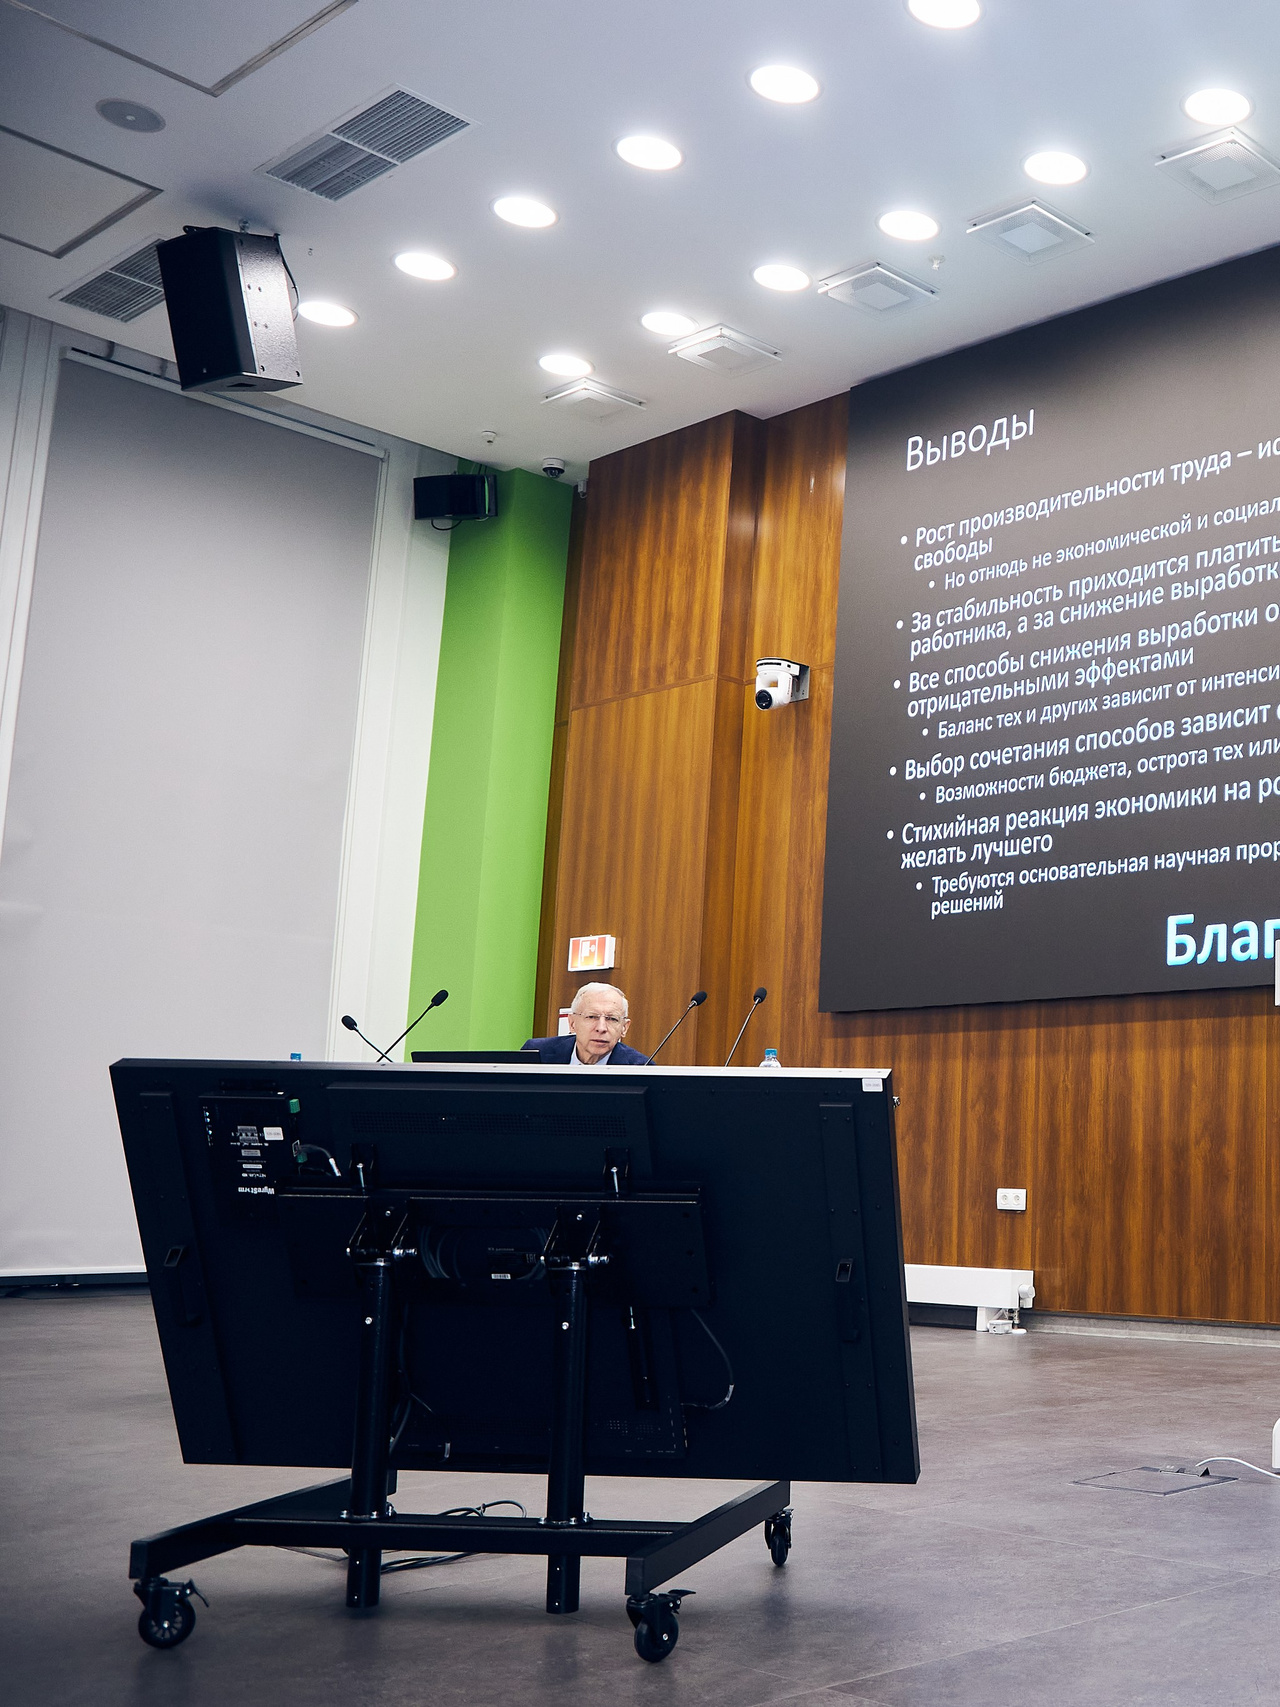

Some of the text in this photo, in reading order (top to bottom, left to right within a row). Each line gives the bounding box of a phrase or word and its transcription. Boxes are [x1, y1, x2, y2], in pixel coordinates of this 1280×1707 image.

[906, 408, 1035, 472] Выводы
[916, 522, 956, 548] Рост
[959, 467, 1165, 539] производительности
[1170, 450, 1231, 485] труда
[914, 537, 993, 571] свободы
[944, 571, 966, 590] Но
[969, 558, 1028, 584] отнюдь
[1032, 552, 1052, 569] не
[1056, 512, 1192, 563] экономической
[1197, 514, 1208, 530] и
[910, 611, 931, 633] За
[936, 584, 1063, 627] стабильность
[1068, 555, 1189, 601] приходится
[910, 620, 1012, 662] работника,
[1017, 615, 1028, 634] а
[1033, 610, 1054, 630] за
[1060, 586, 1164, 624] снижение
[909, 671, 940, 693] Все
[944, 650, 1024, 686] способы
[1029, 632, 1131, 669] снижения
[1138, 607, 1258, 648] выработки
[907, 646, 1194, 720] отрицательными эффектами
[938, 716, 993, 739] Баланс
[996, 710, 1022, 729] тех
[1026, 707, 1037, 724] и
[1039, 696, 1098, 725] других
[1101, 683, 1173, 710] зависит
[1176, 679, 1198, 697] от
[905, 752, 965, 781] Выбор
[969, 737, 1070, 770] сочетания
[1075, 717, 1175, 753] способов
[1180, 704, 1272, 736] зависит
[935, 773, 1045, 804] Возможности
[1049, 761, 1132, 788] бюджета,
[1137, 748, 1208, 774] острота
[1212, 743, 1244, 762] тех
[901, 813, 1000, 845] Стихийная
[1005, 803, 1089, 837] реакция
[1094, 785, 1217, 820] экономики
[1224, 780, 1251, 802] на
[900, 833, 1053, 870] желать лучшего
[931, 871, 1015, 898] Требуются
[1018, 855, 1149, 885] основательная
[1154, 846, 1231, 872] научная
[931, 888, 1004, 920] решений
